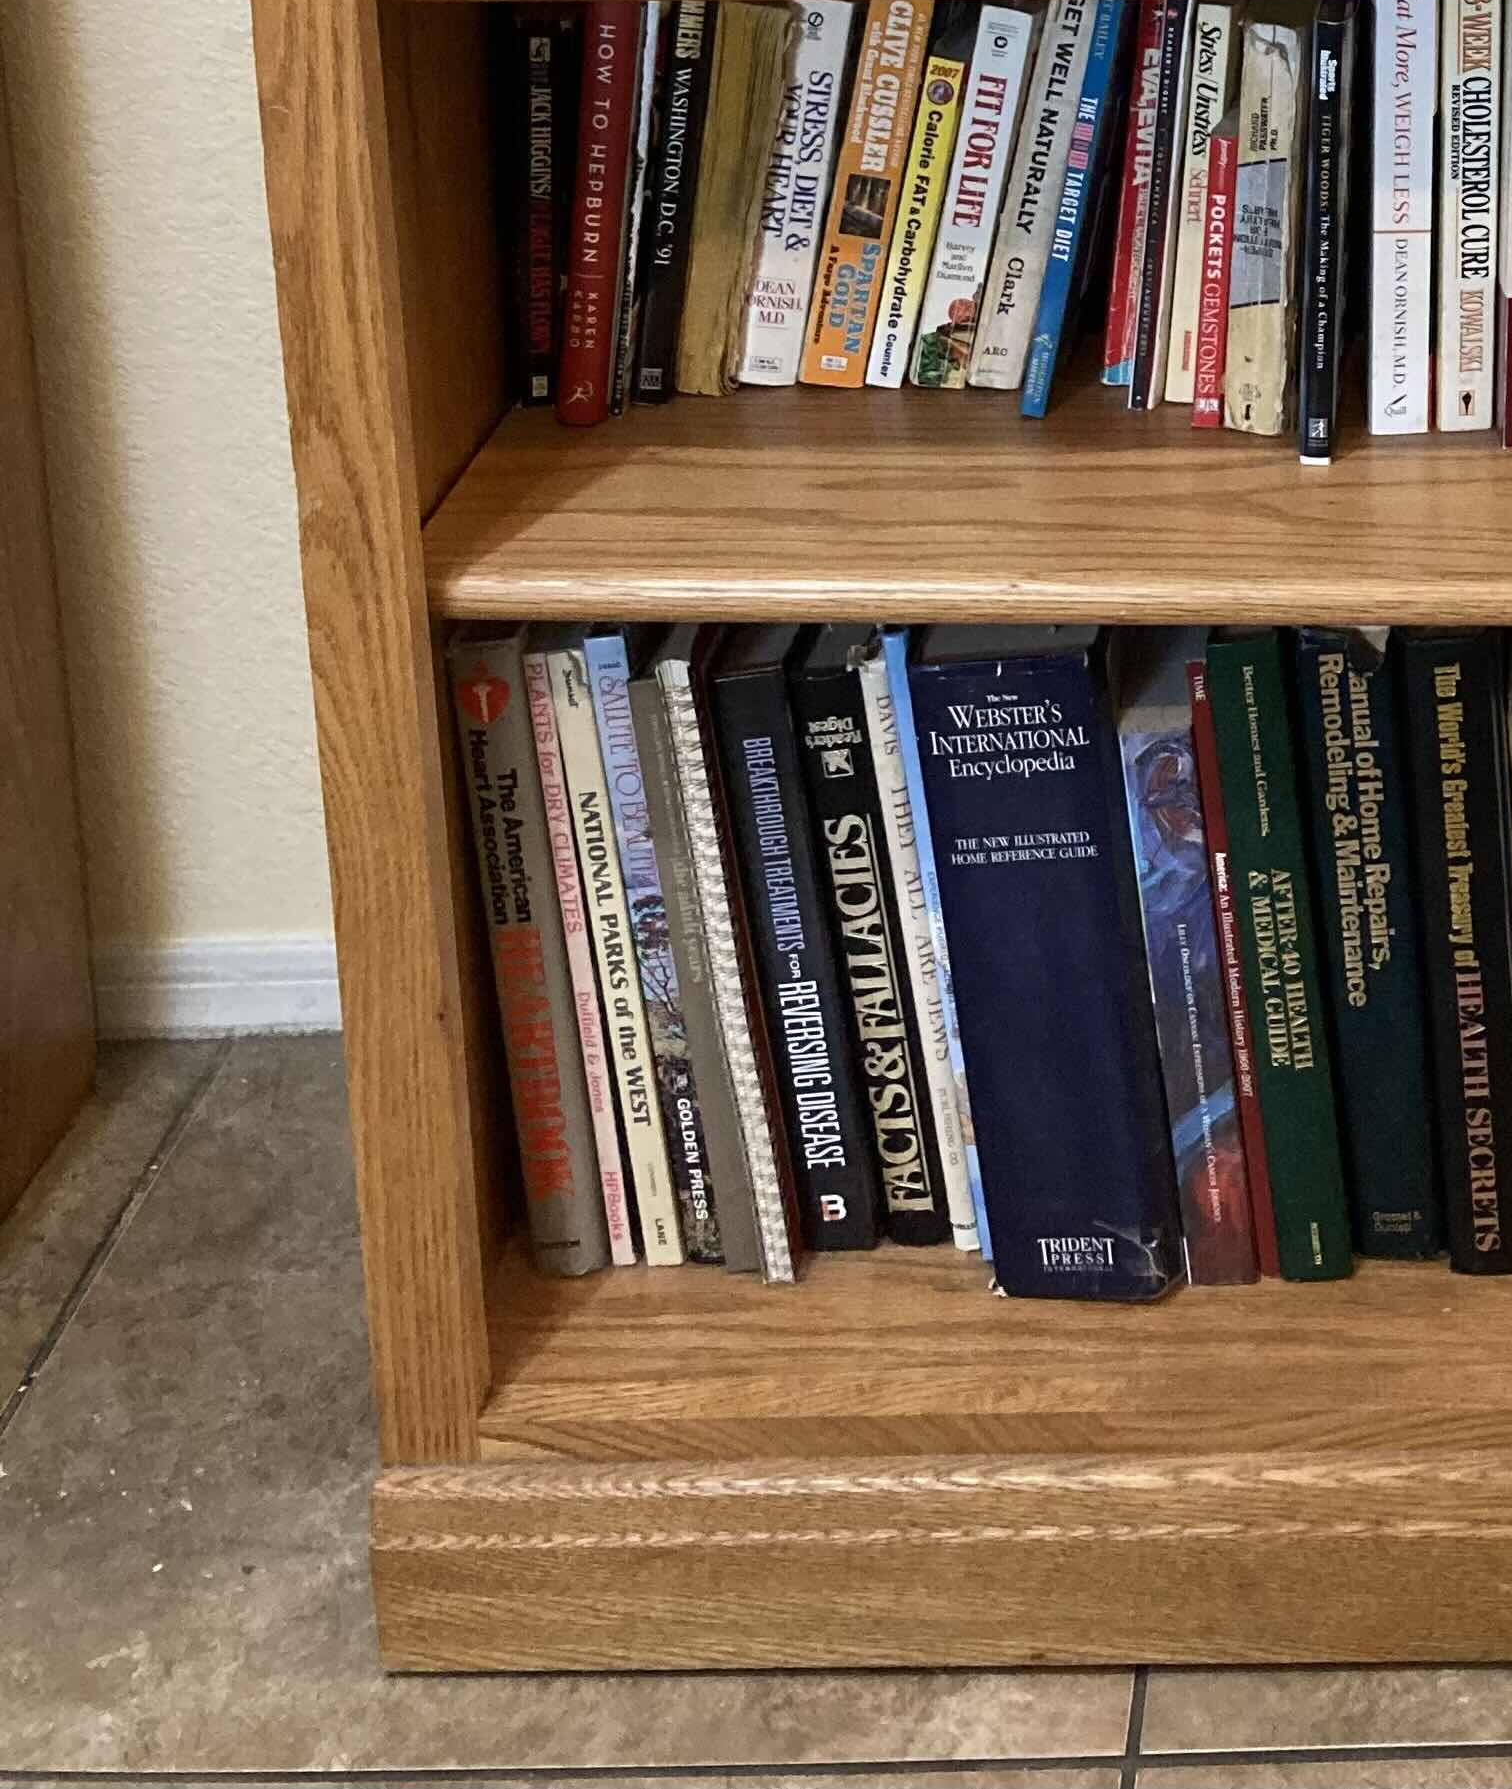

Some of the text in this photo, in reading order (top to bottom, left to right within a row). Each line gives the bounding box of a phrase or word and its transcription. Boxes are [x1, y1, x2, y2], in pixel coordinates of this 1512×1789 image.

[929, 63, 960, 78] 2007
[582, 24, 616, 262] HOW TO HEPBURN
[951, 73, 1008, 229] FIT FOR LIFE
[1013, 43, 1075, 234] WELL NATURALLY
[877, 218, 924, 376] Carbohydrate Counter
[996, 257, 1025, 316] Clark
[1197, 194, 1226, 397] POCKETS GEMSTONES
[949, 700, 1062, 731] WEBSTER'S
[930, 728, 1090, 757] INTERNATIONAL
[949, 753, 1075, 780] Encyclopedia
[951, 845, 1099, 865] HOME REFERENCE GUIDE
[955, 831, 1089, 850] THE NEW ILLUSTRATED
[578, 791, 651, 1126] NATIONAL PARKS of the WEST
[677, 1097, 709, 1220] GOLDEN PRESS
[654, 1217, 667, 1246] LANE
[1038, 1237, 1114, 1260] TRIDENT
